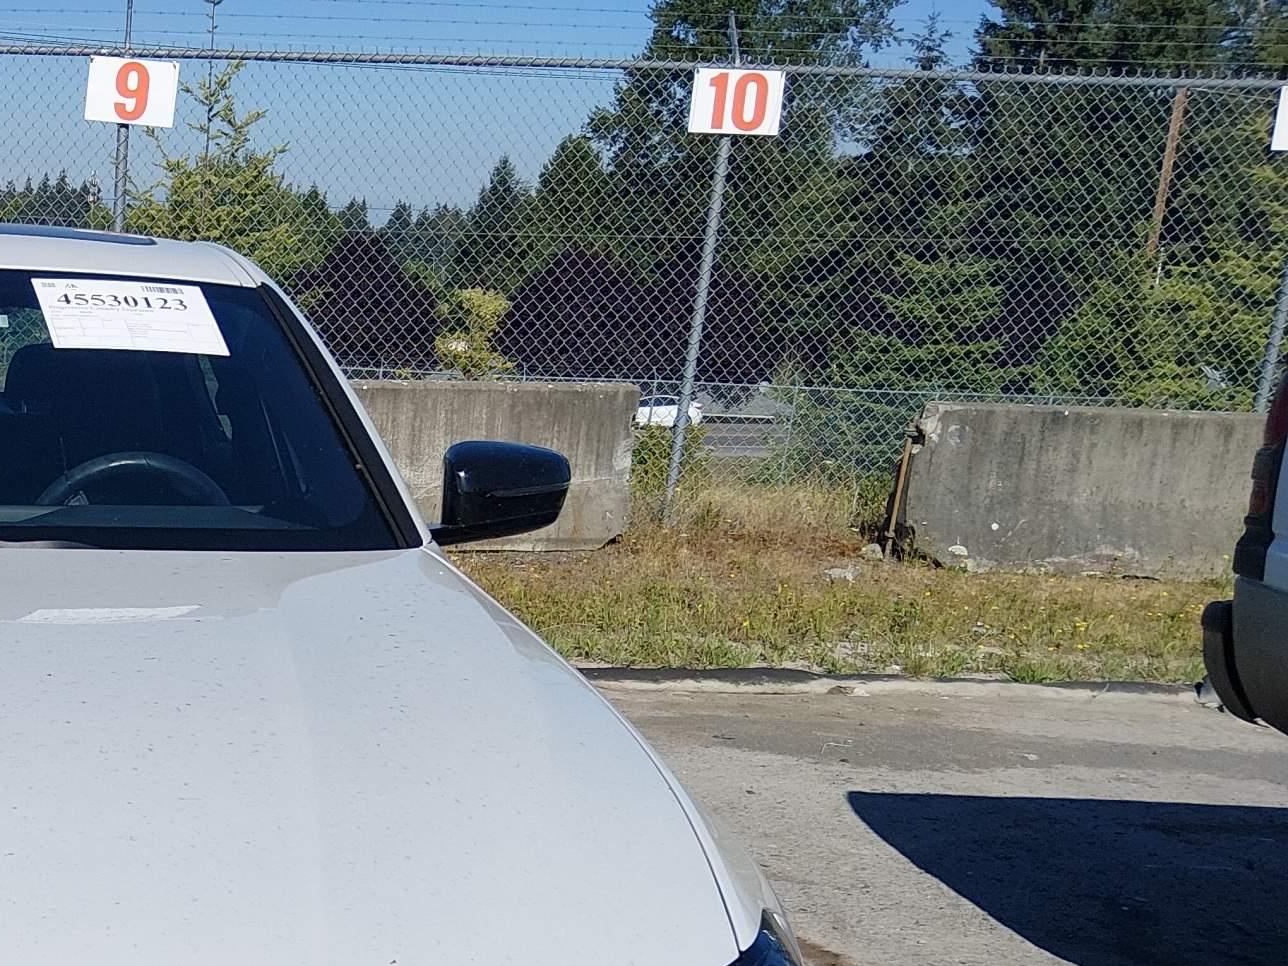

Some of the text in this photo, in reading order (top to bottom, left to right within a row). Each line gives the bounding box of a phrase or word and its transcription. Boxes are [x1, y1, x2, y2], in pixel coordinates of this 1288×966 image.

[113, 61, 150, 121] 9
[709, 72, 769, 131] 10
[57, 293, 188, 311] 45530123
